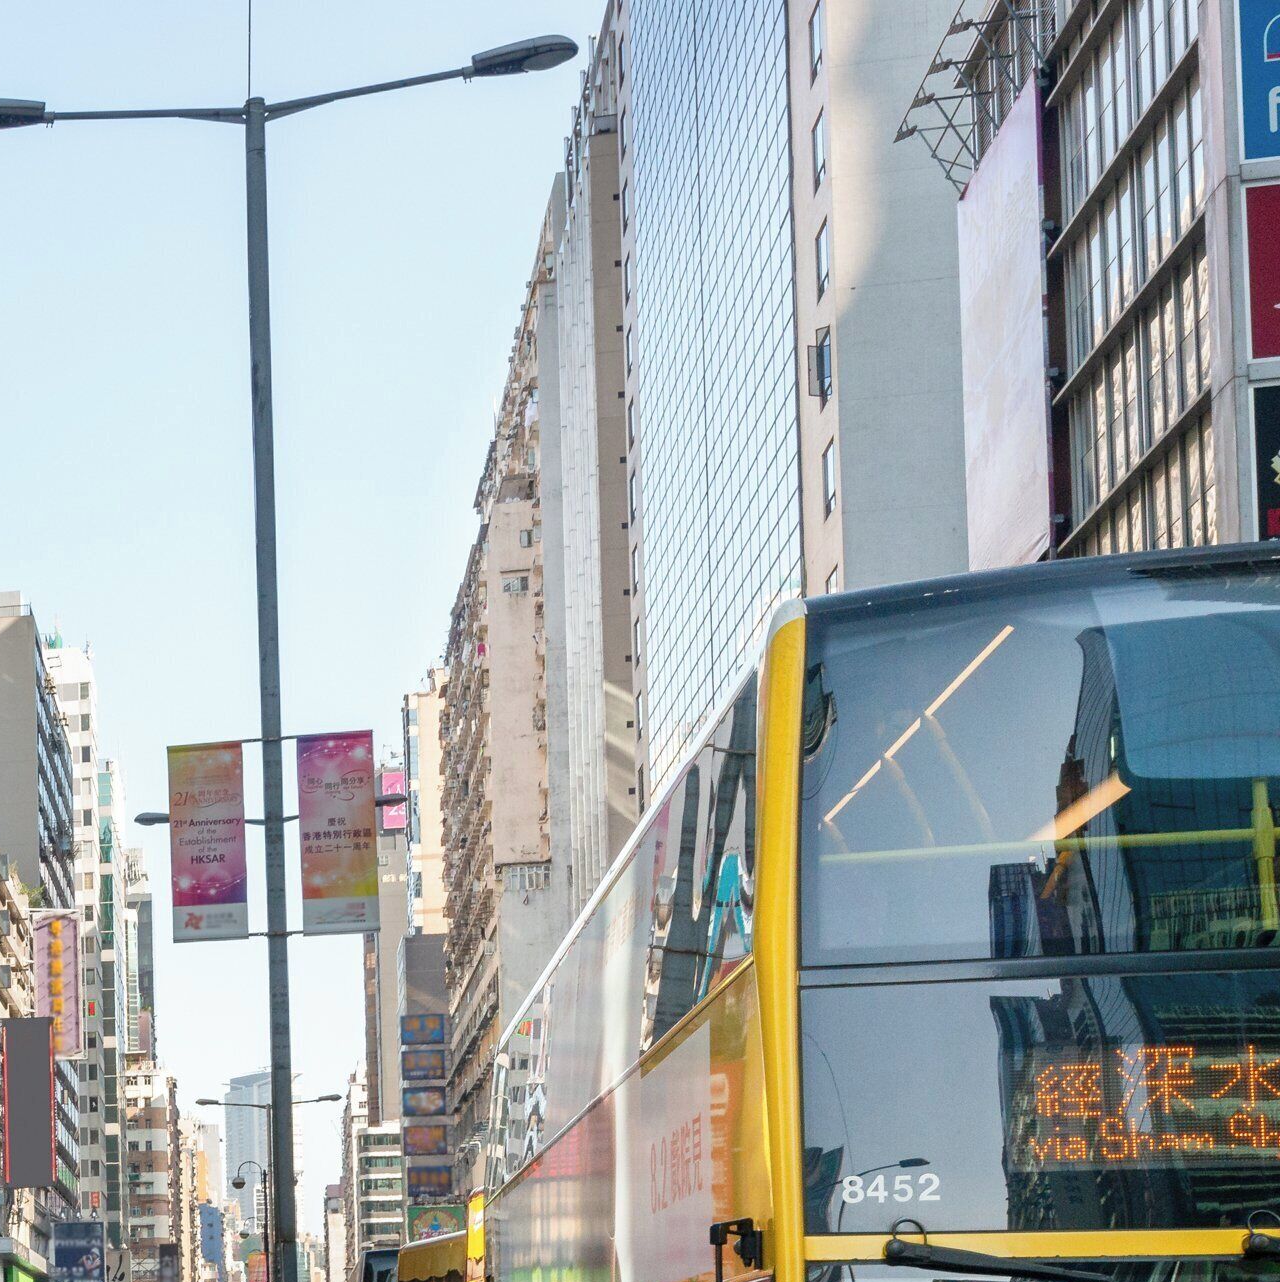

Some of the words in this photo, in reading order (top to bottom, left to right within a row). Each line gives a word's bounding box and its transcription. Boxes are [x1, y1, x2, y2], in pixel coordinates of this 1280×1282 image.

[189, 817, 242, 829] Anniversary
[327, 817, 347, 827] 慶祝
[179, 835, 237, 846] Establishment
[303, 828, 372, 841] 香港特別行政區
[304, 841, 371, 854] 成立二十一周年
[191, 854, 226, 865] HKSAR
[1029, 1126, 1087, 1161] via
[1101, 1116, 1215, 1159] Sham
[842, 1172, 941, 1204] 8452
